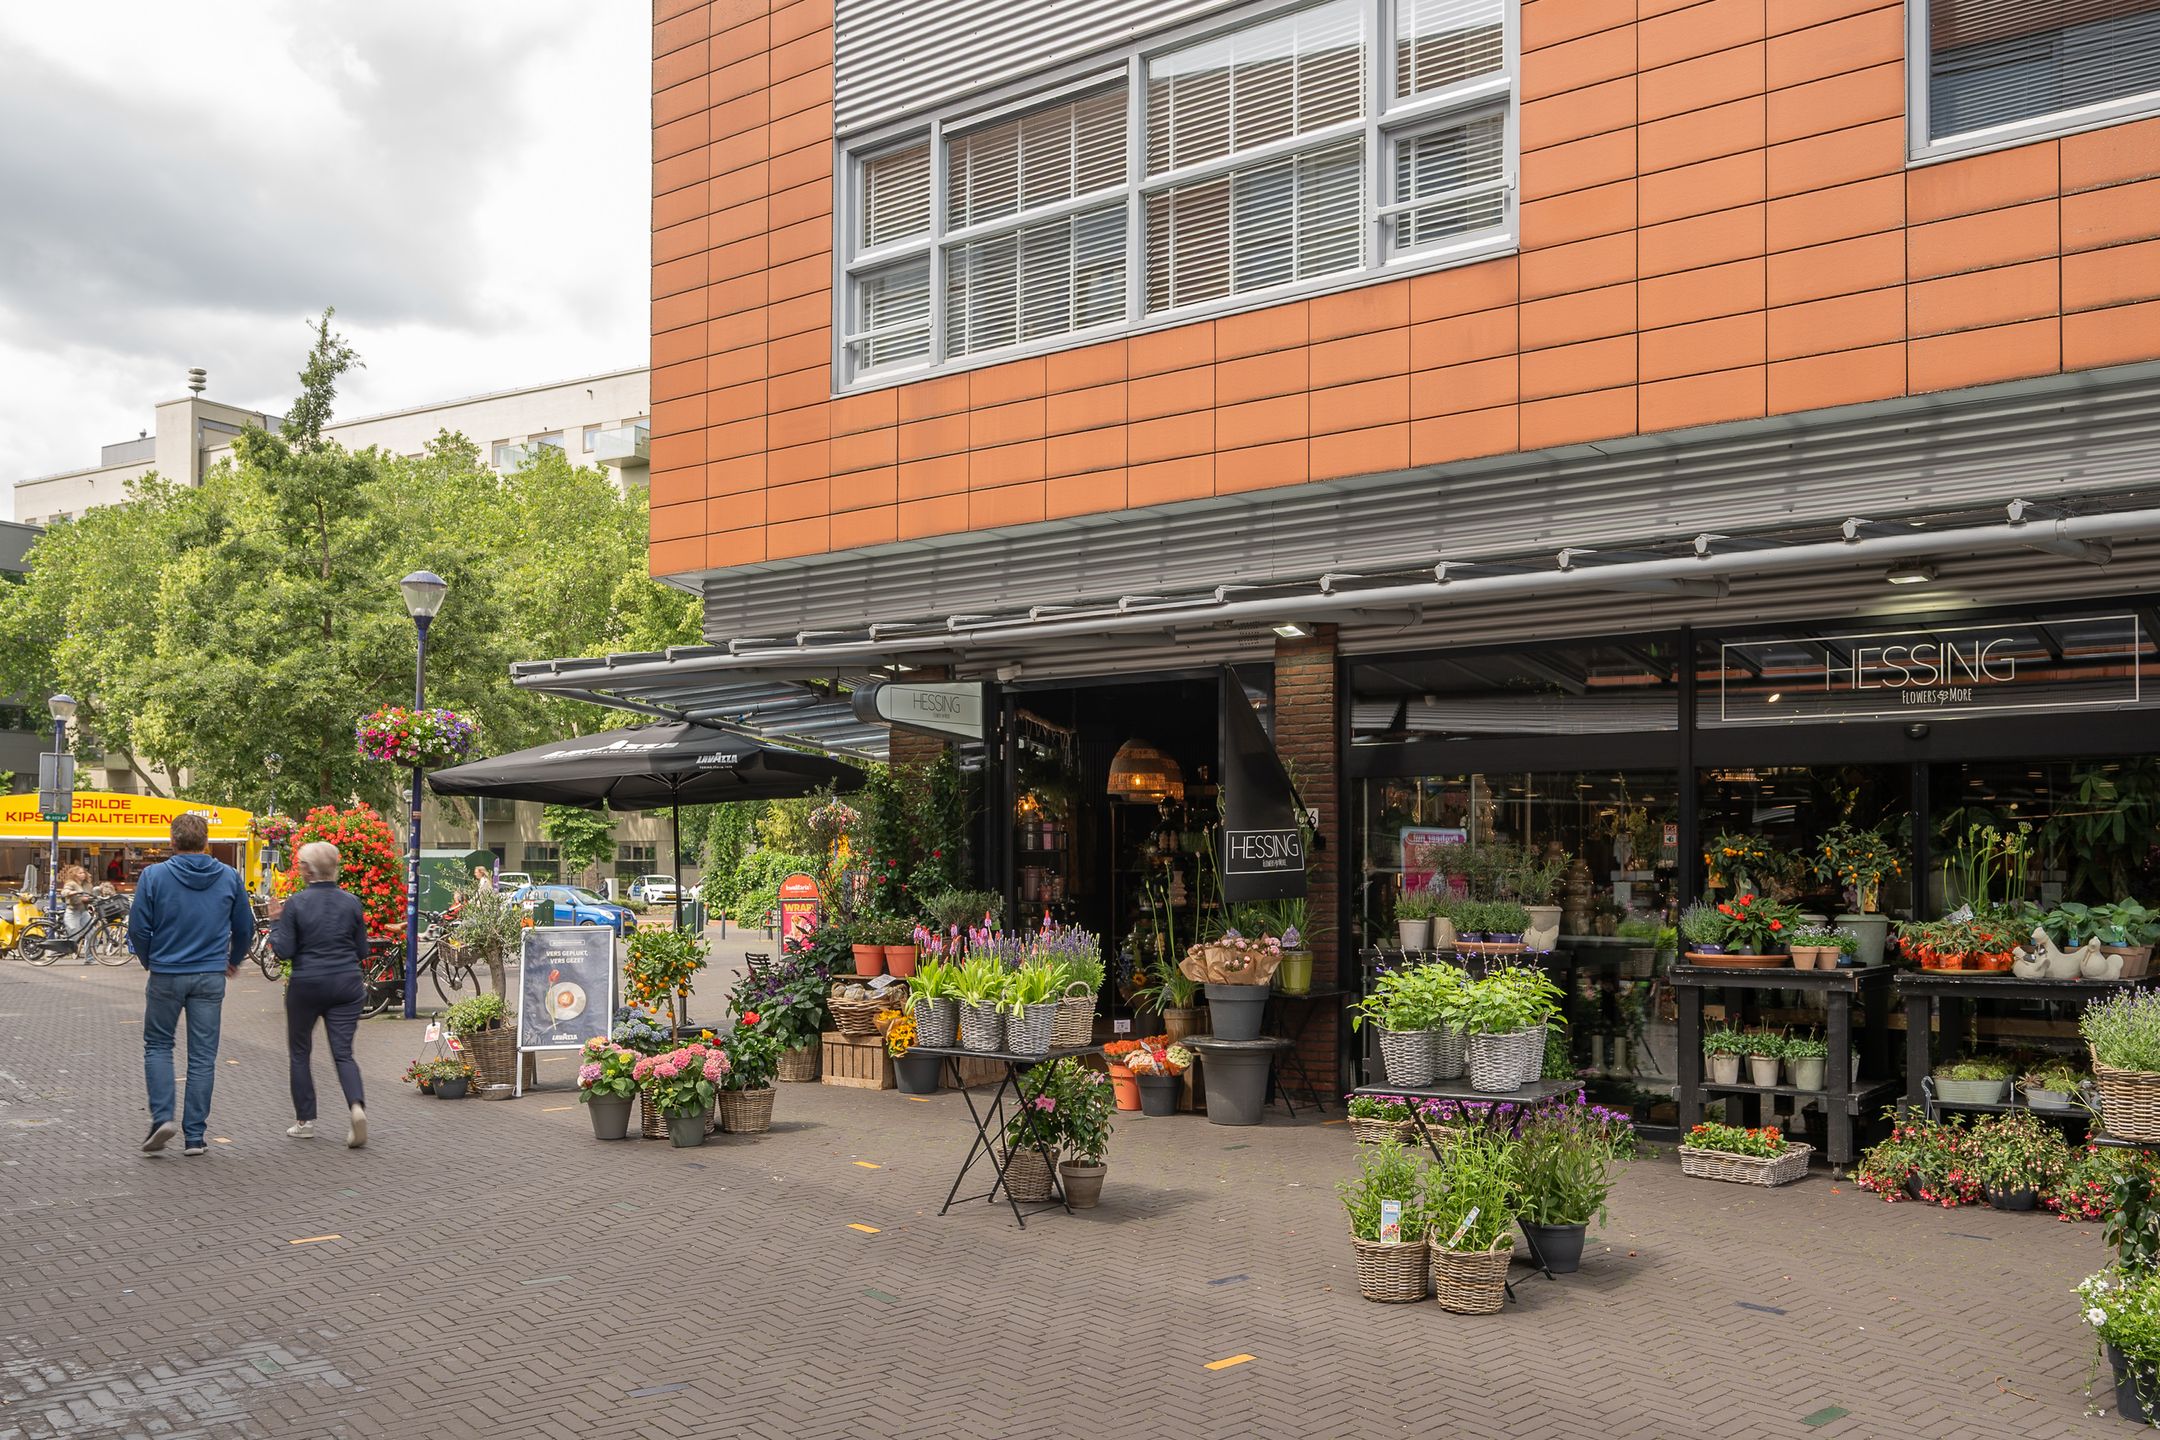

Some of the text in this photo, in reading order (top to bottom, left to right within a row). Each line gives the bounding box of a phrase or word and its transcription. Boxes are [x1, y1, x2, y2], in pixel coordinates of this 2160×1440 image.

[1826, 638, 2015, 691] HESSING
[912, 692, 961, 714] HESSING
[1902, 687, 1972, 705] FLOWERS MORE
[695, 752, 738, 764] LAVAZZA
[5, 811, 173, 824] KIPSCIALITEITEN
[1231, 833, 1299, 859] HESSING
